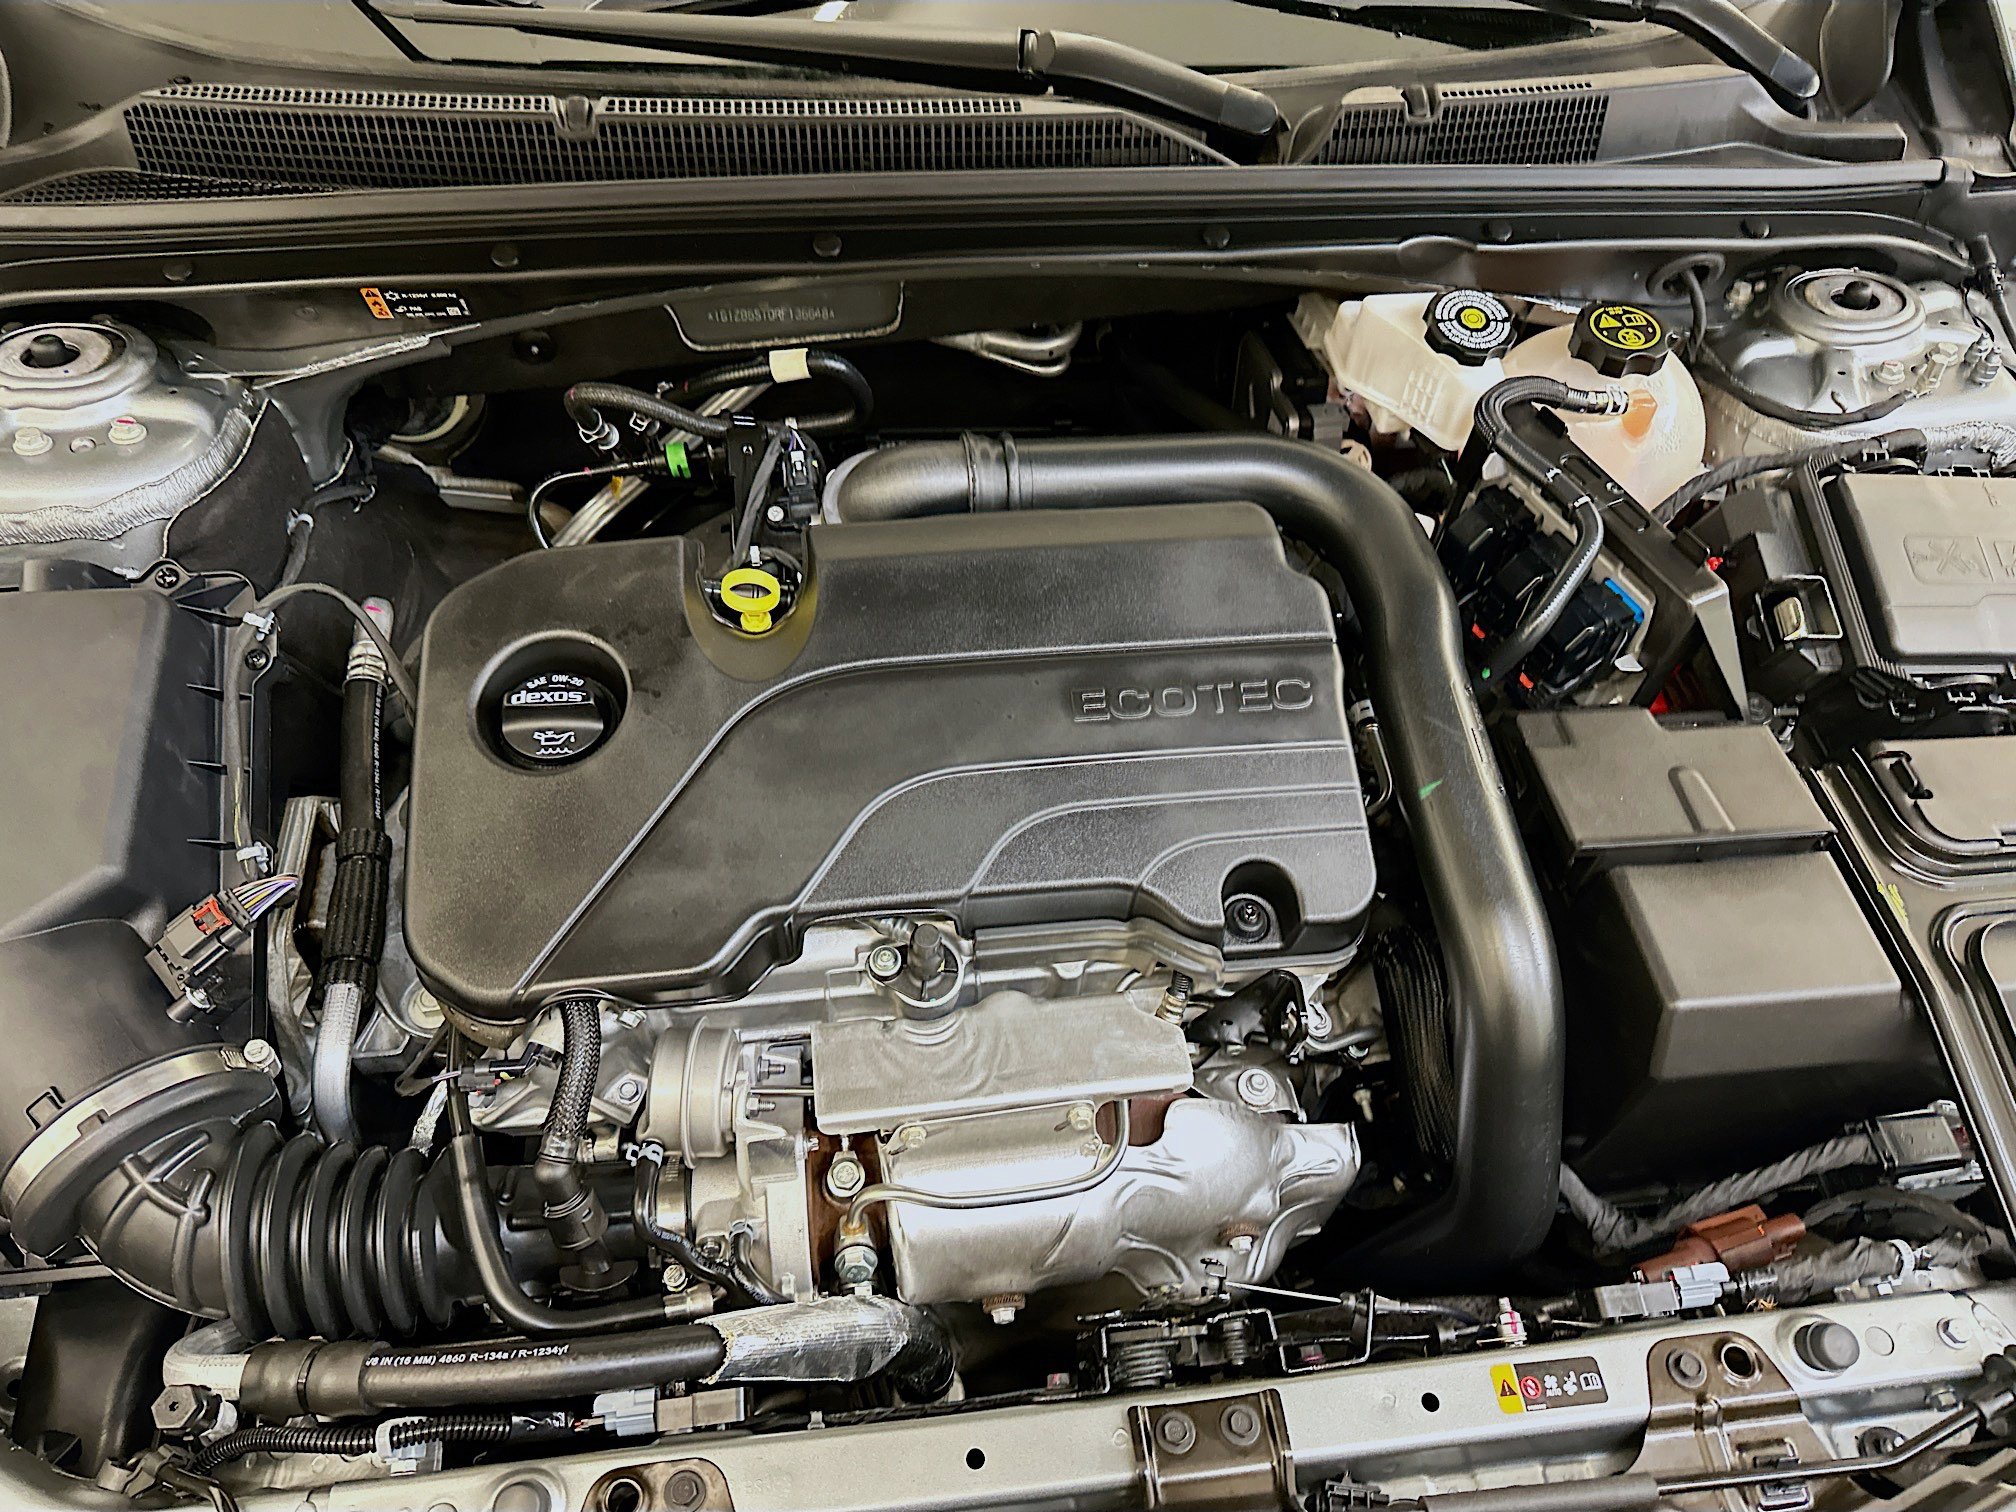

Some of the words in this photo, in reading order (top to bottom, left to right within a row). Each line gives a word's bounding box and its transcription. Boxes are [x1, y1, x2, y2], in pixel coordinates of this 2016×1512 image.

[526, 676, 548, 689] SAE
[551, 674, 585, 687] 0W-20
[510, 690, 583, 705] dexos
[1071, 677, 1314, 722] ECOTEC
[380, 1356, 393, 1366] IN
[413, 1355, 437, 1366] MM)
[438, 1353, 466, 1364] 4860
[468, 1351, 509, 1362] R-134a
[510, 1349, 517, 1359] /
[517, 1344, 570, 1359] R-1234yf
